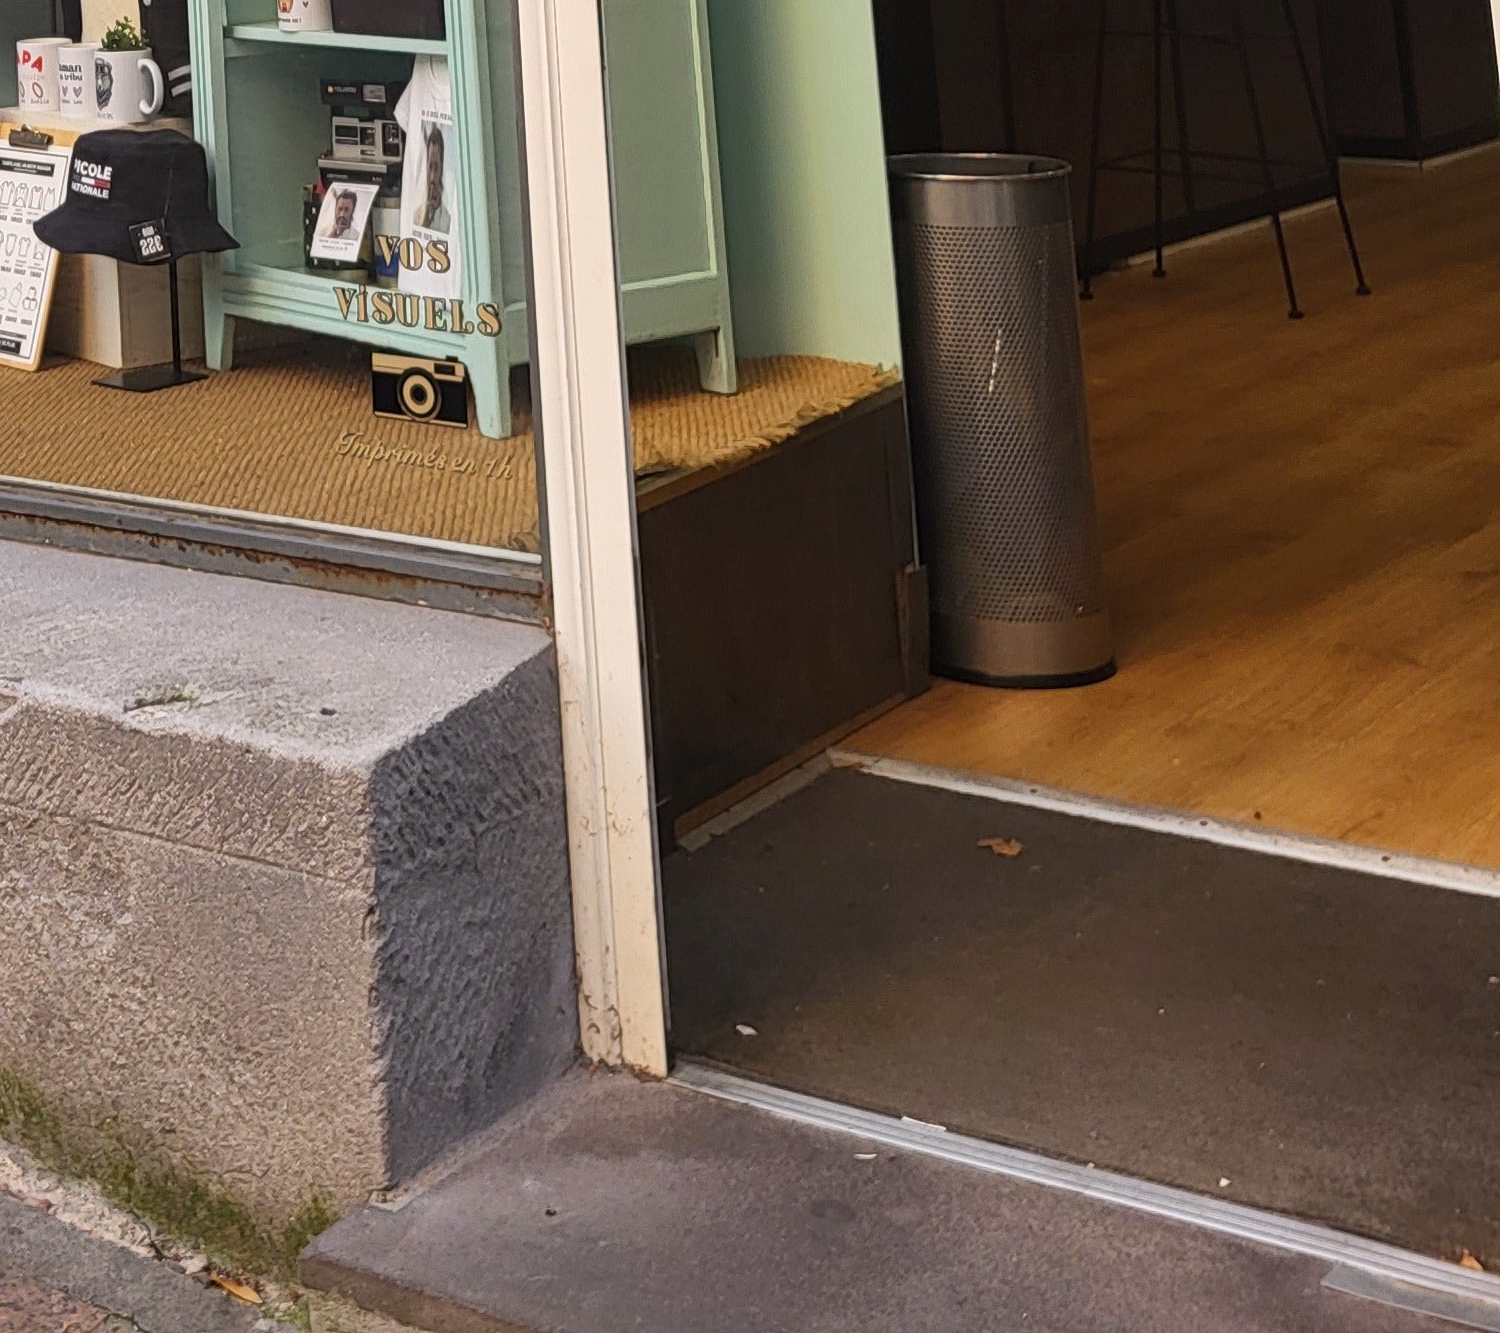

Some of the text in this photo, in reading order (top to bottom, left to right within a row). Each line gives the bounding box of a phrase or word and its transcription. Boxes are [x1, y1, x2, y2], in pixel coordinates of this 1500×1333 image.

[376, 235, 451, 274] VOS
[336, 431, 513, 480] Imprimés en 1h
